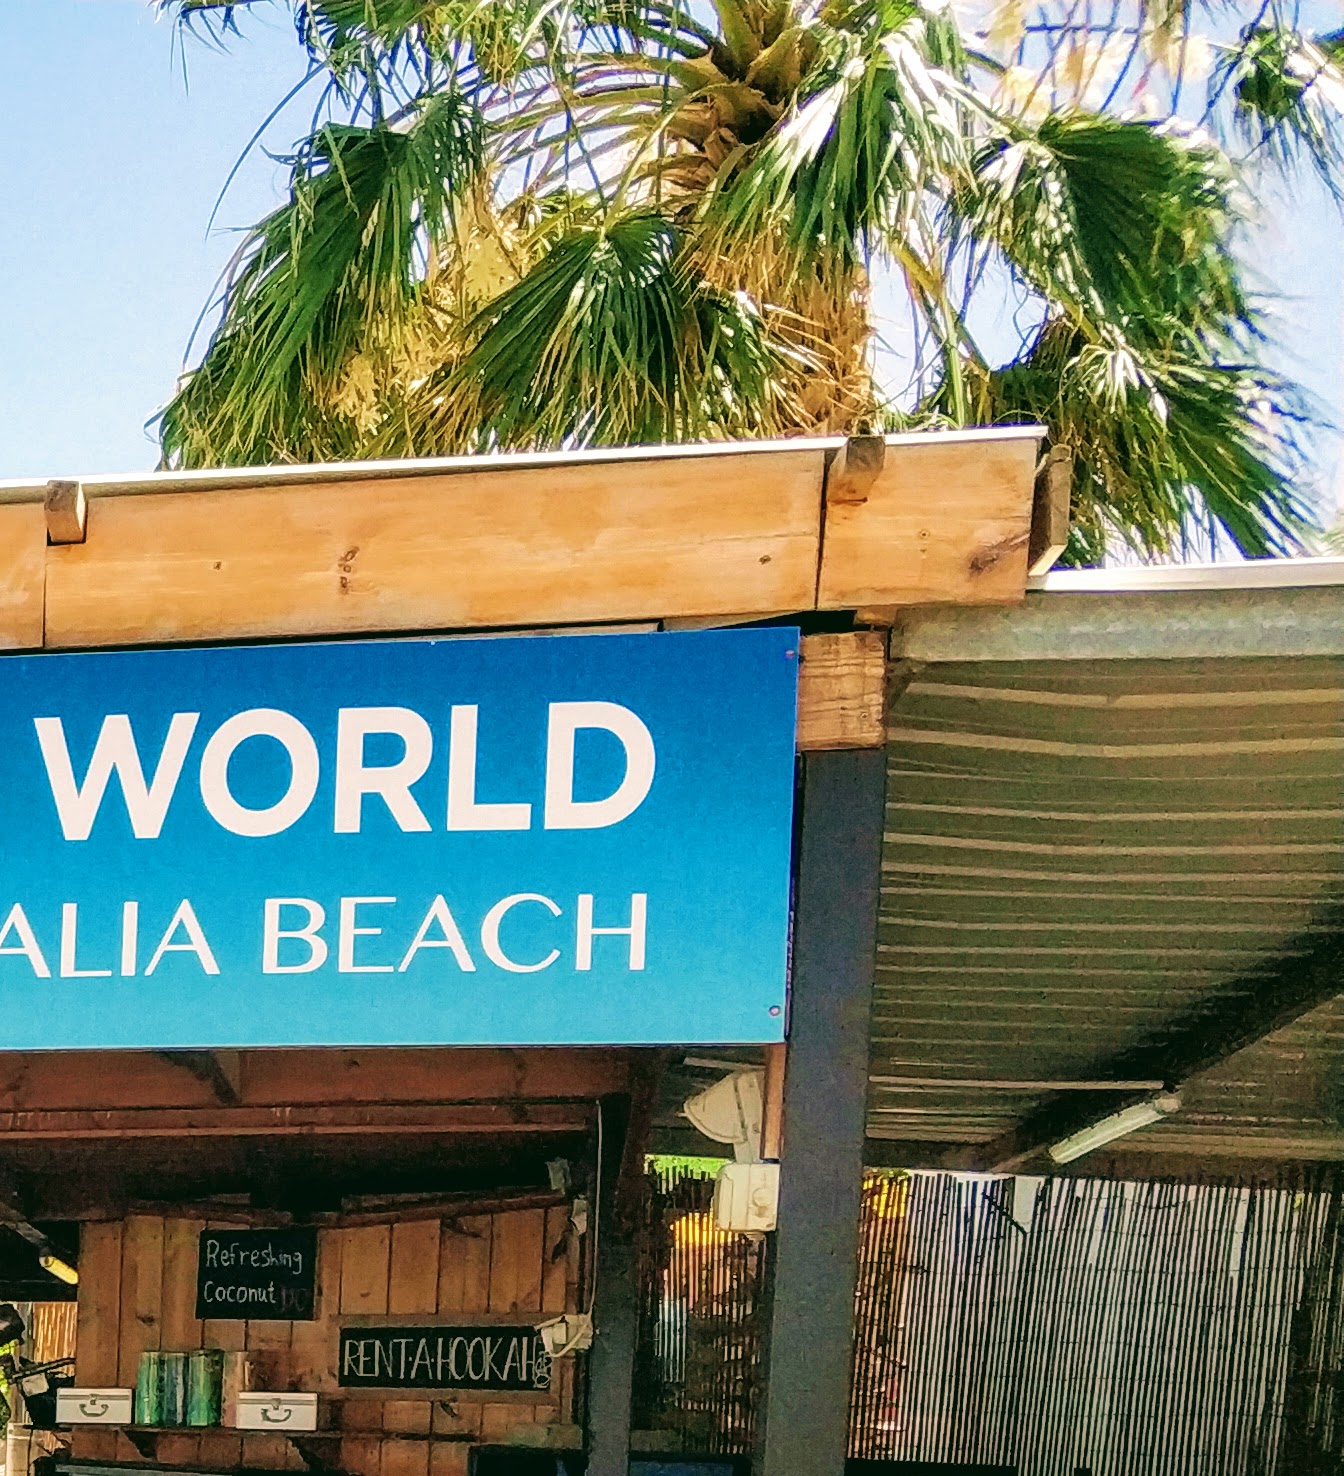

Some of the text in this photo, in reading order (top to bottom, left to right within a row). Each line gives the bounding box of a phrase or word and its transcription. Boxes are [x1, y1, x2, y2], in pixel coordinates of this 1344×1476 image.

[32, 701, 657, 842] WORLD
[261, 892, 648, 975] BEACH
[203, 1280, 277, 1304] Coconut
